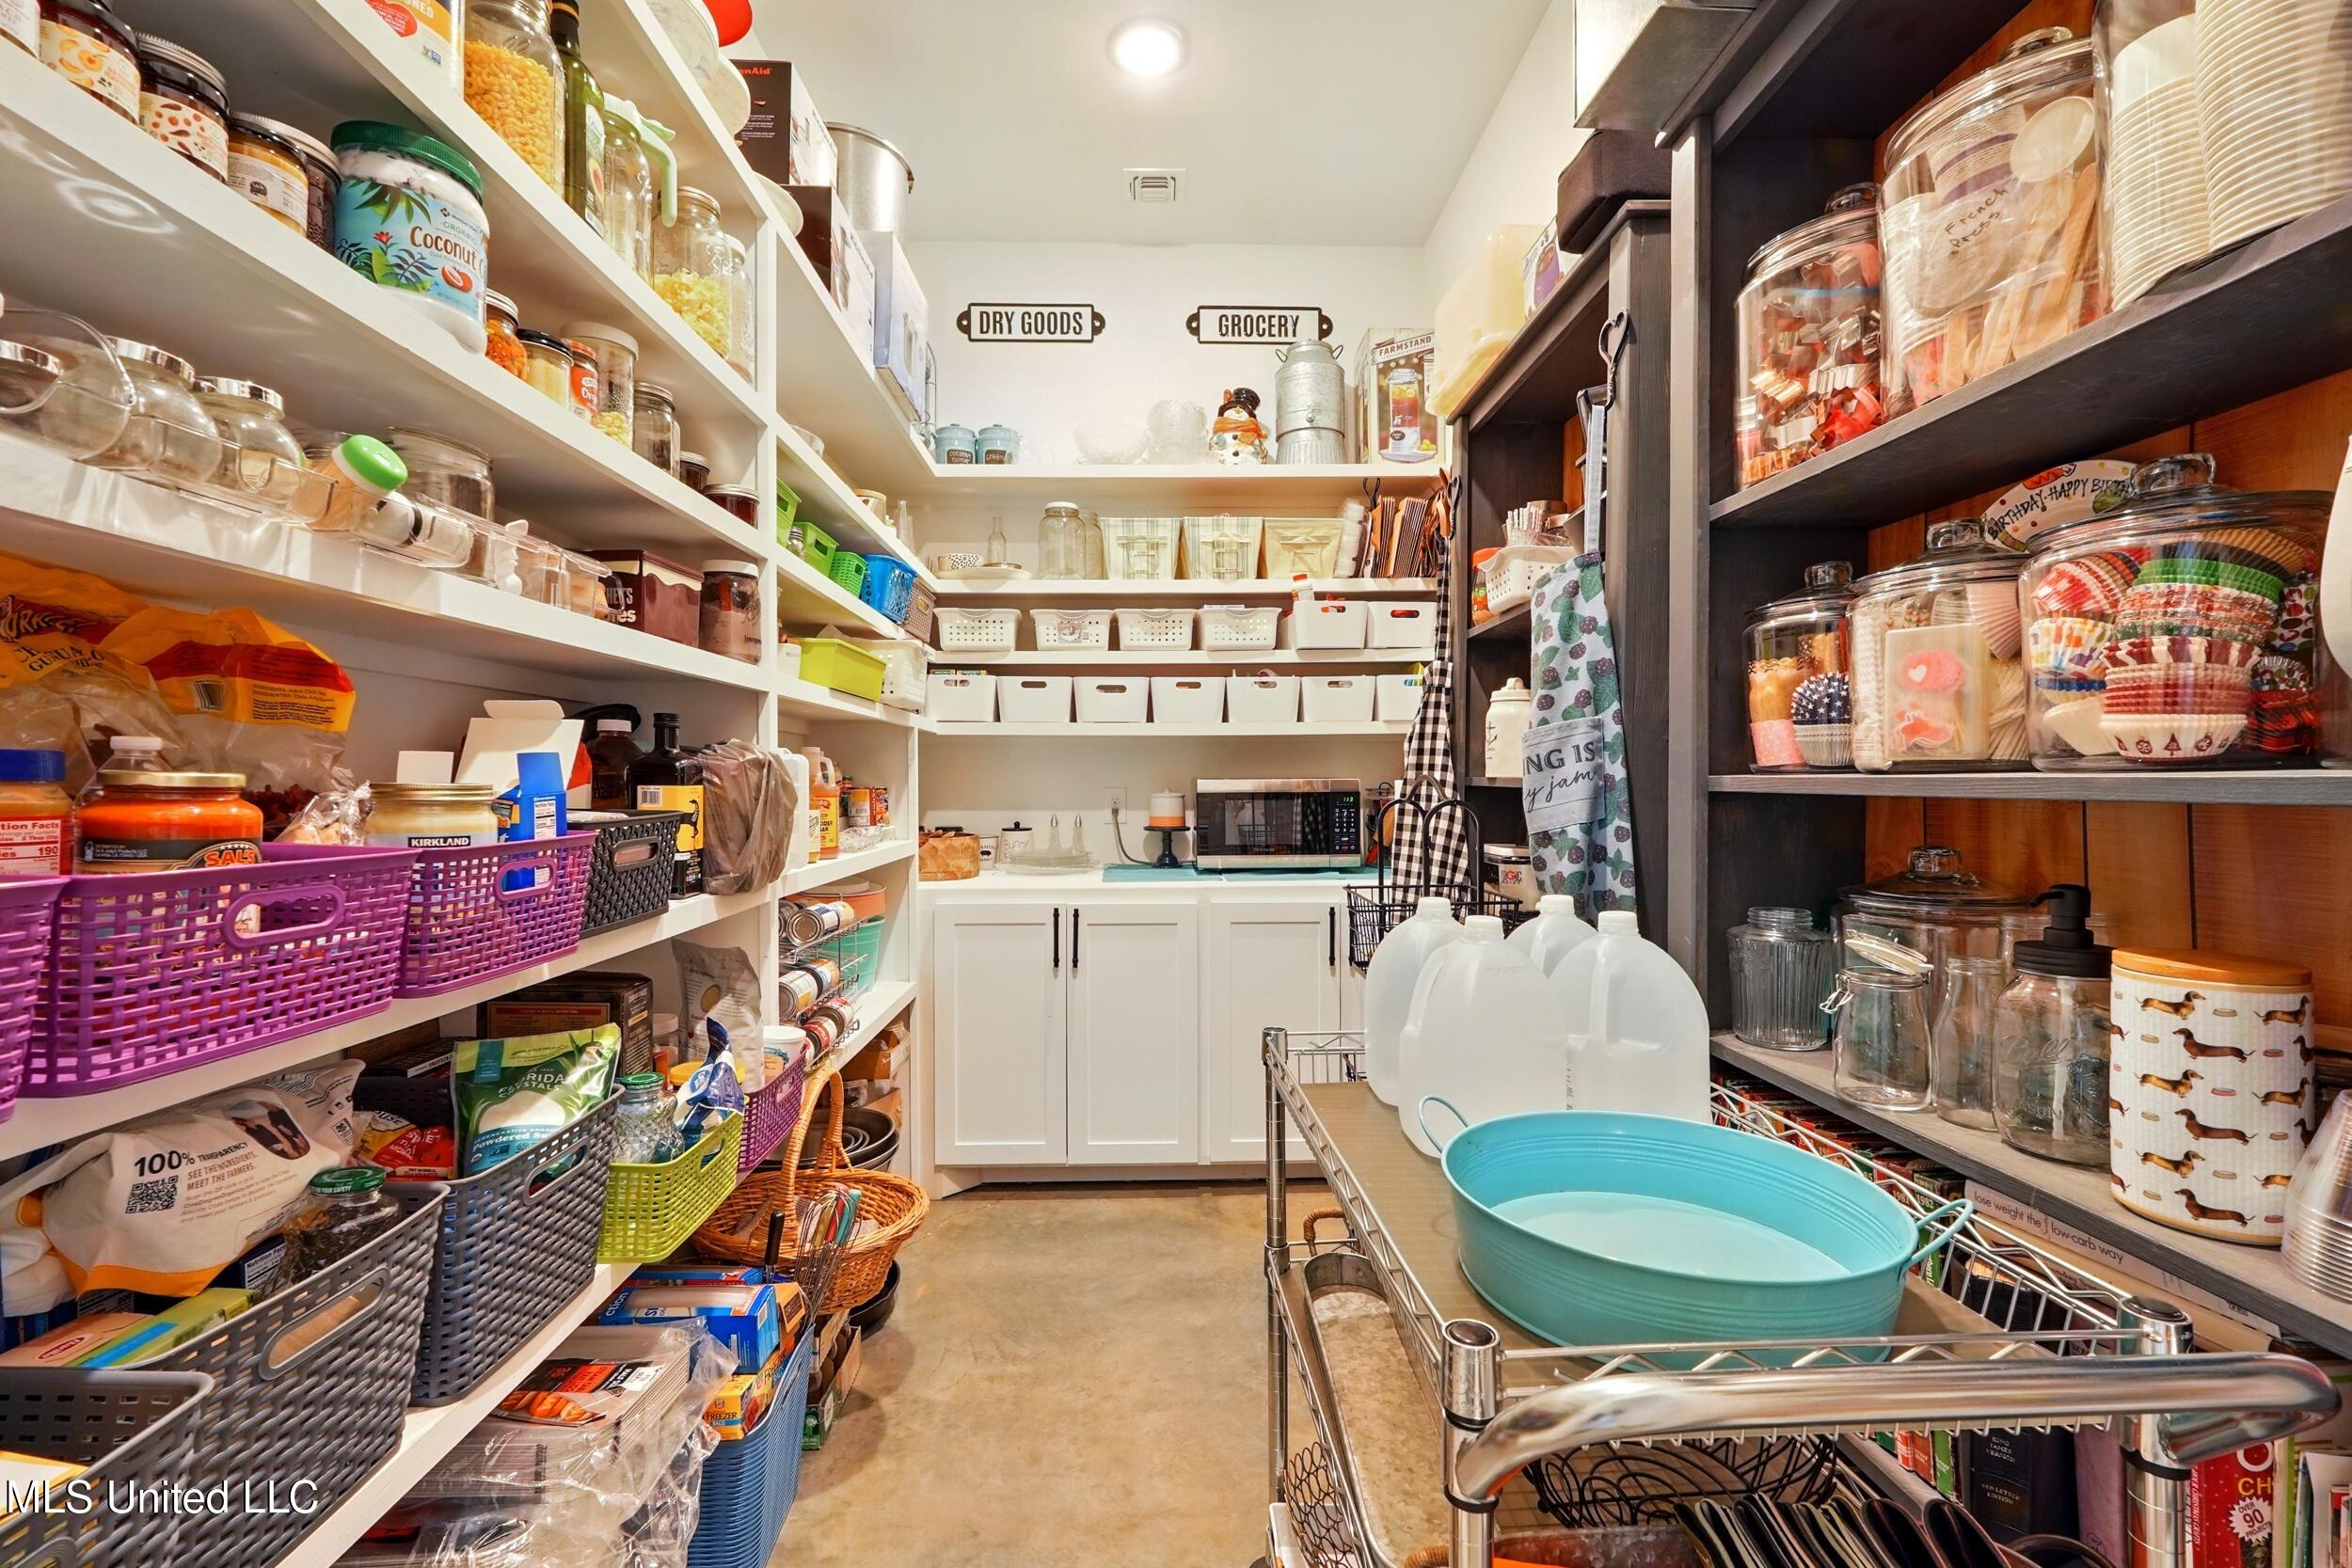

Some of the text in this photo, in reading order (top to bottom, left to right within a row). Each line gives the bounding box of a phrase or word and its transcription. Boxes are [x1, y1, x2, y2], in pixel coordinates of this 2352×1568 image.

[410, 226, 477, 270] Coconut
[979, 310, 1083, 335] DRY GOODS
[1218, 314, 1299, 338] GROCERY
[1379, 335, 1432, 356] FARMSTAND
[2048, 479, 2089, 501] HAPPY
[2090, 478, 2130, 497] BIRTH
[1523, 741, 1596, 776] NG IS
[1524, 770, 1596, 813] y jam
[39, 846, 58, 855] 190
[411, 837, 469, 847] KIRKLAND
[204, 849, 256, 867] SAL'S
[376, 1110, 404, 1126] USE
[472, 1132, 532, 1153] Powdered
[135, 1150, 195, 1177] 100%
[186, 1179, 209, 1192] MEET
[212, 1175, 226, 1185] THE
[188, 1169, 202, 1180] SEE
[1893, 1189, 1934, 1210] 1981 1982
[1974, 1189, 2123, 1265] lose weight the low-carb way
[273, 1244, 286, 1255] Fact
[706, 1412, 738, 1420] FREEZER
[1990, 1443, 2012, 1454] JAMES
[1992, 1435, 2010, 1447] KING
[1994, 1486, 2021, 1500] LETTER
[2237, 1477, 2273, 1496] CH
[2238, 1501, 2256, 1513] OVER
[2243, 1509, 2265, 1528] 90
